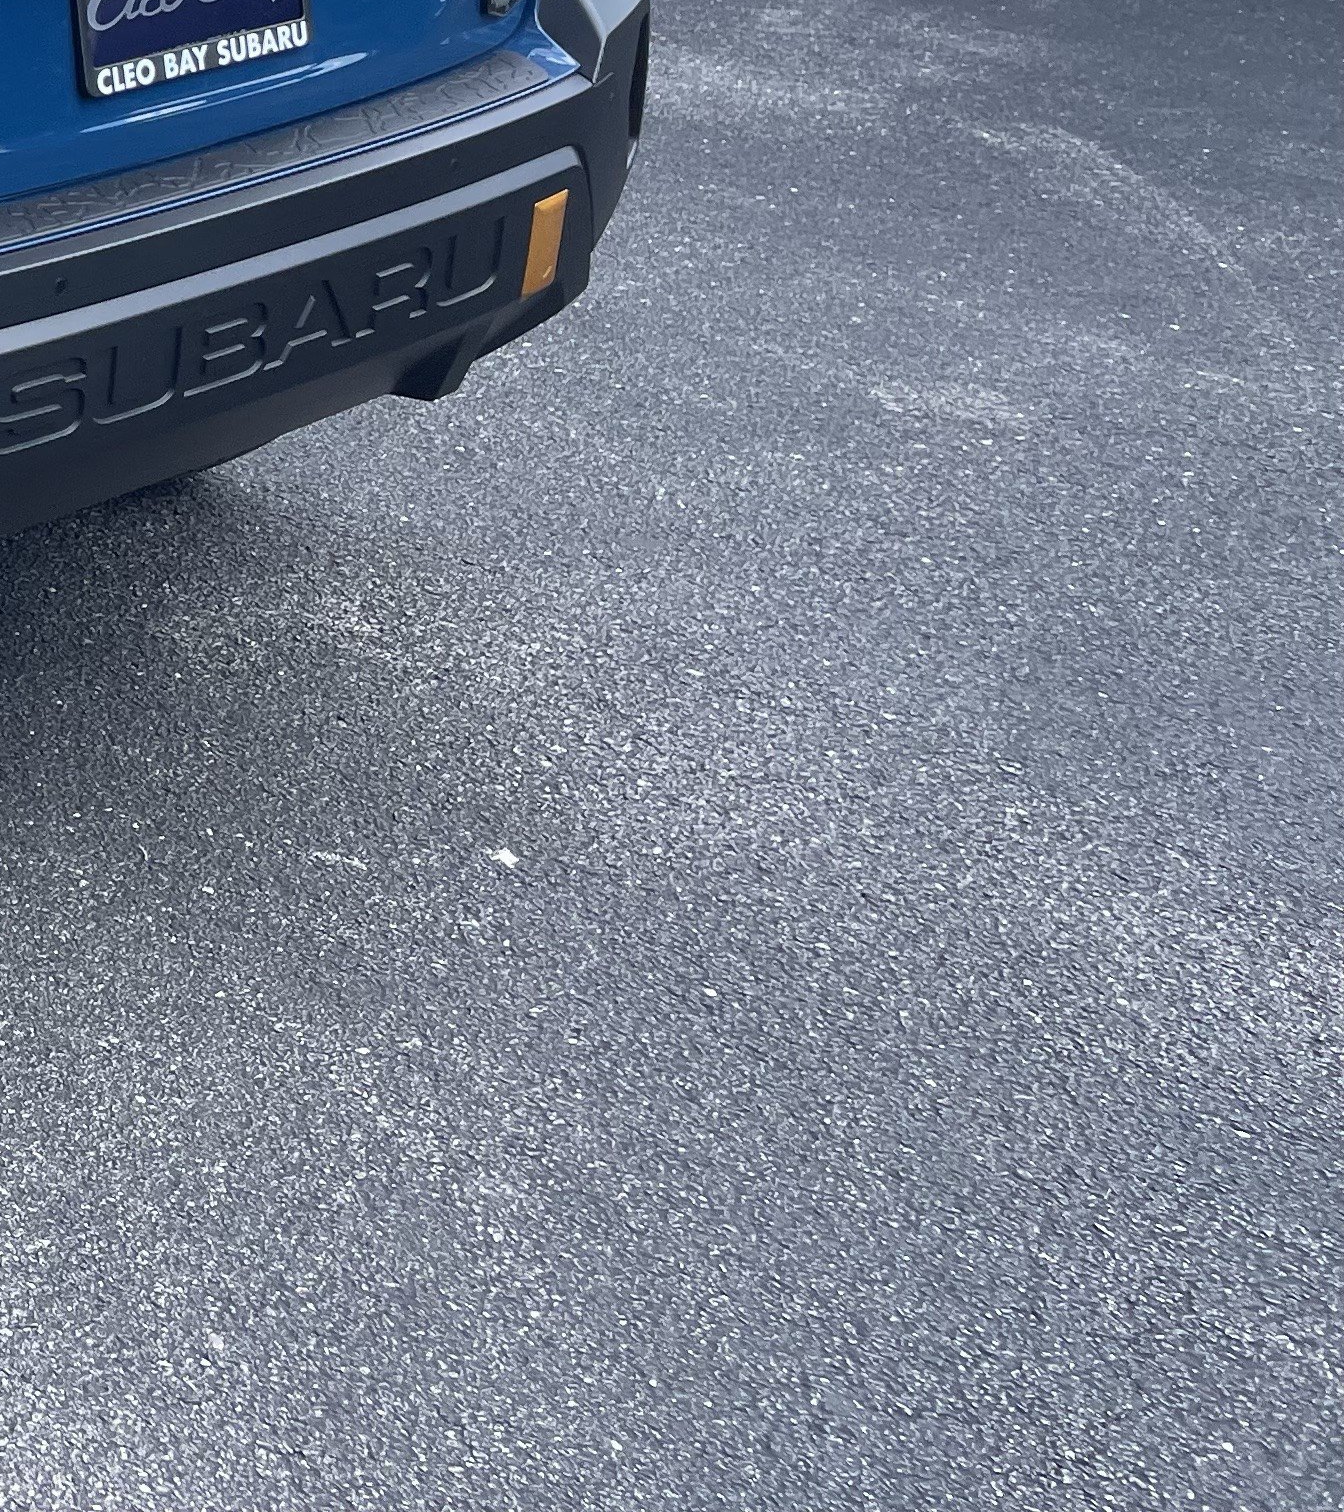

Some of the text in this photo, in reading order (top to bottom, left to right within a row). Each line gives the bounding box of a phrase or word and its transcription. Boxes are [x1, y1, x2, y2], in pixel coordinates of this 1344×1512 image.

[96, 20, 308, 96] CLEO BAY SUBARU
